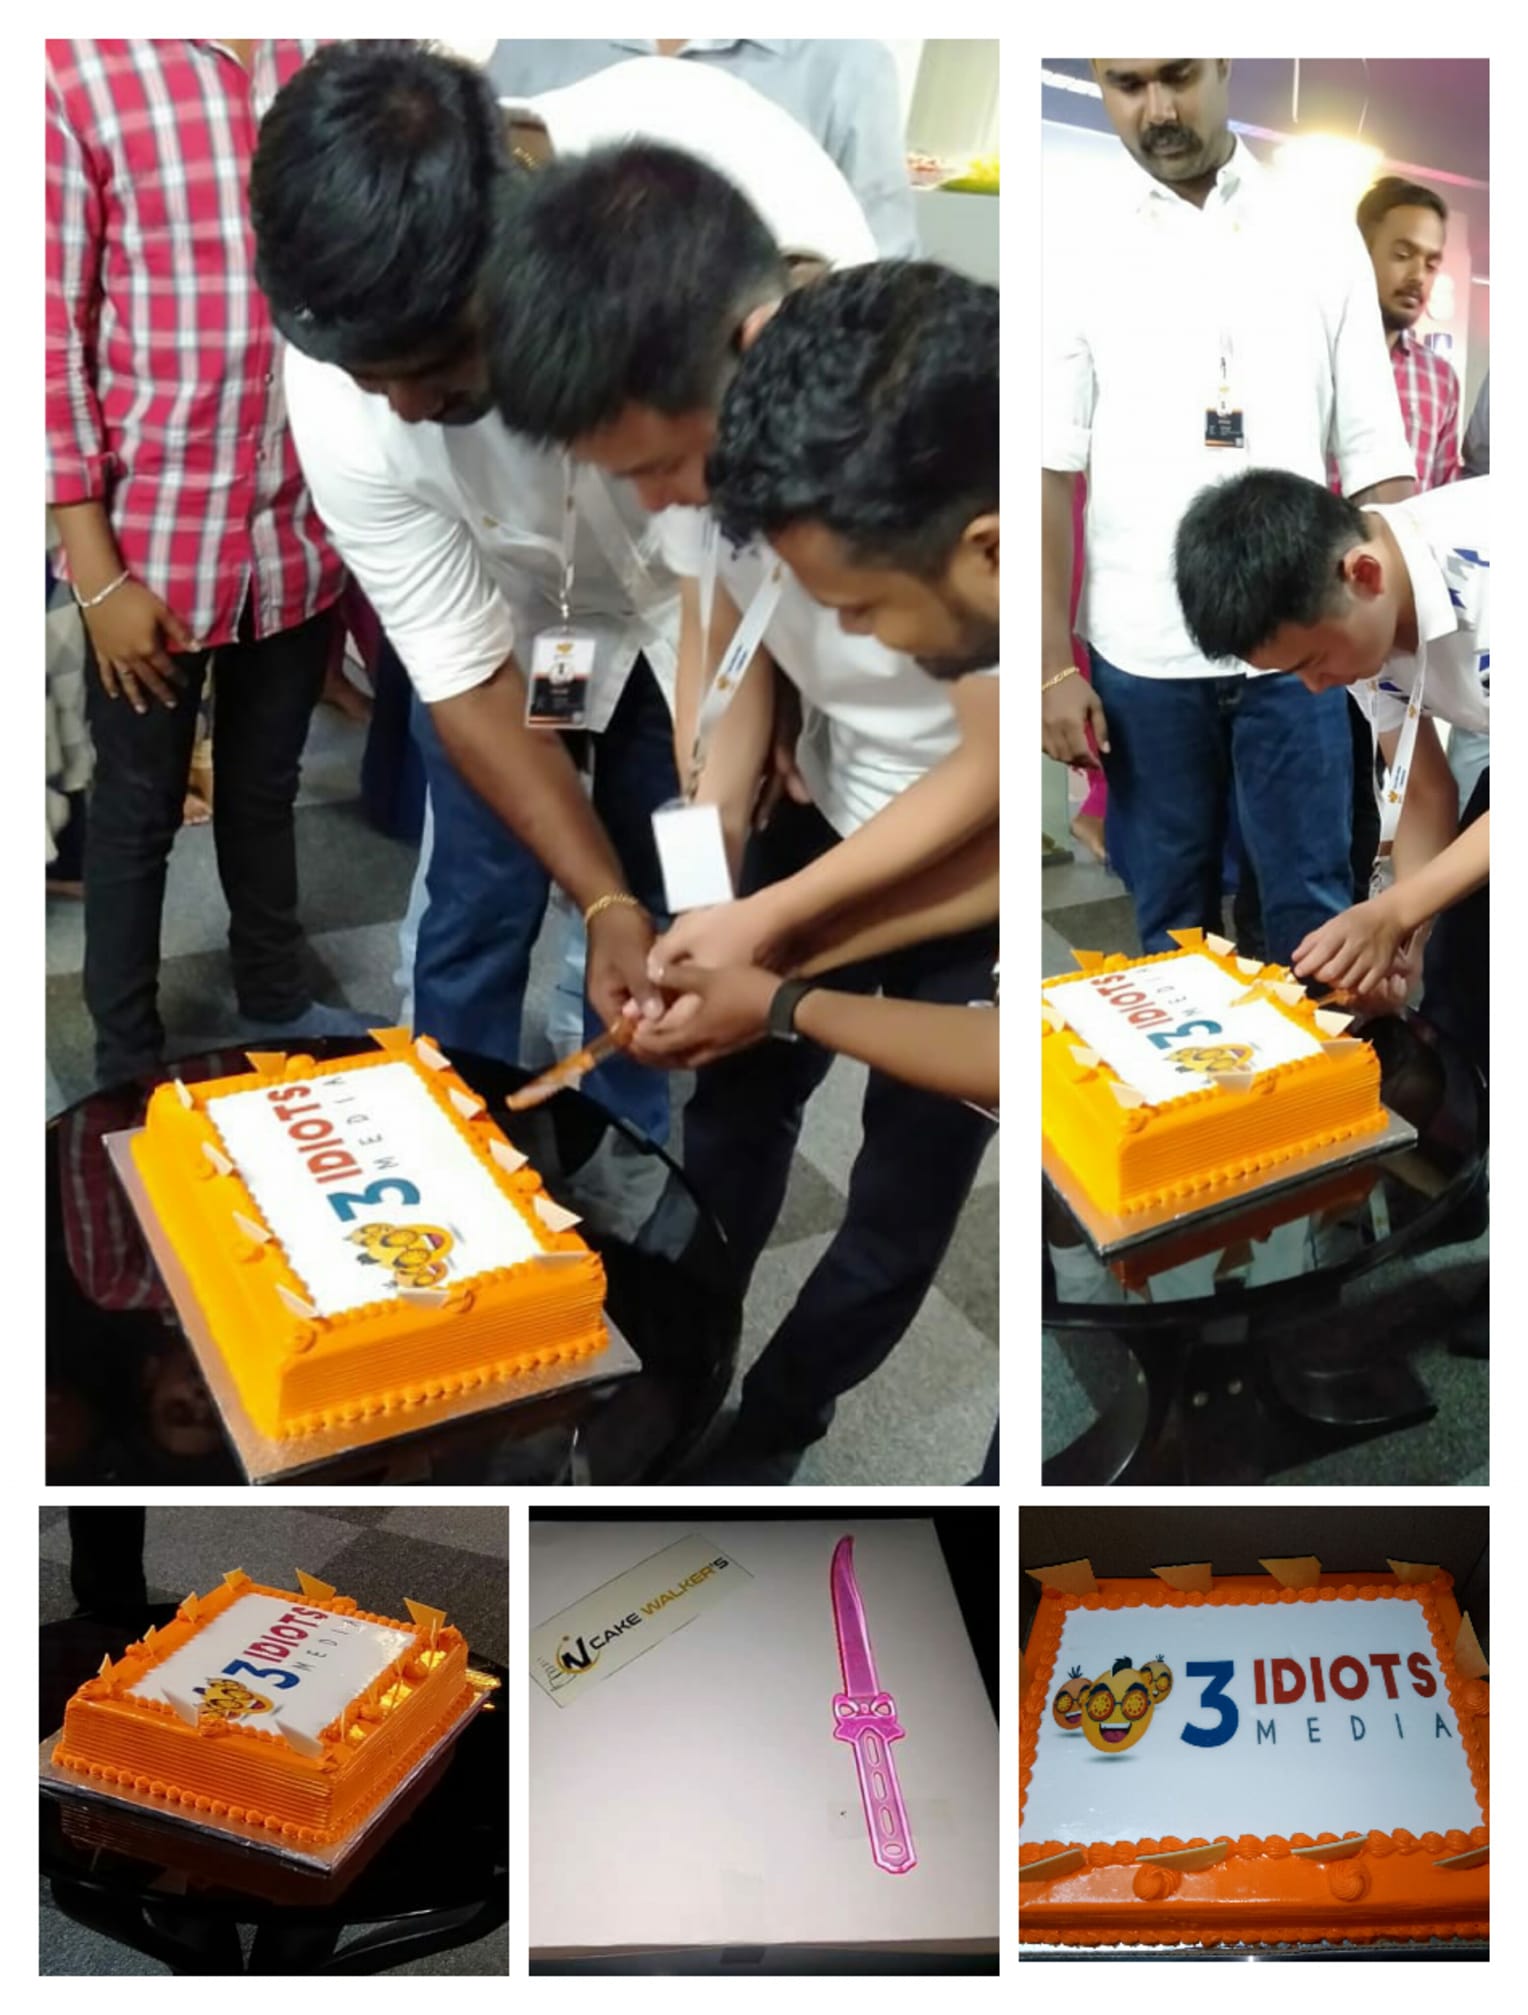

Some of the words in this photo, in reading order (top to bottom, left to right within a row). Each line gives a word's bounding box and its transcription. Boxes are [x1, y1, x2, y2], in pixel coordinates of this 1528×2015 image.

[1090, 974, 1174, 1030] IDIOTS
[1146, 1019, 1223, 1050] 3
[267, 1085, 363, 1184] IDIOTS
[323, 1076, 399, 1170] MEDIA
[326, 1177, 421, 1222] 3
[589, 1612, 642, 1650] CAKE
[641, 1556, 730, 1616] WALKER'S
[243, 1606, 329, 1664] IDIOTS
[221, 1659, 301, 1690] 3
[1179, 1660, 1239, 1748] 3
[1253, 1651, 1438, 1705] IDIOTS
[1256, 1711, 1453, 1745] MEDIA
